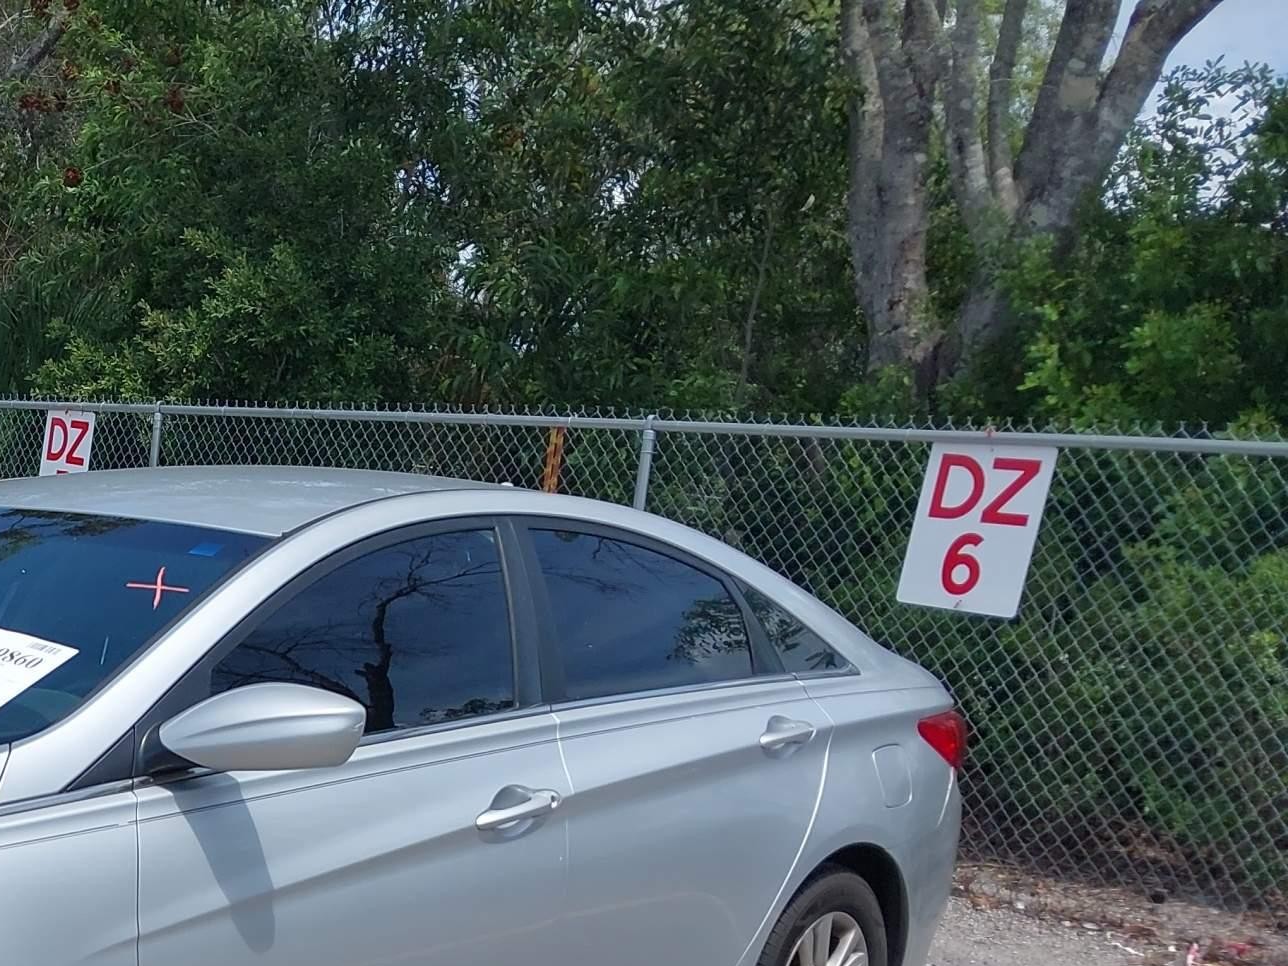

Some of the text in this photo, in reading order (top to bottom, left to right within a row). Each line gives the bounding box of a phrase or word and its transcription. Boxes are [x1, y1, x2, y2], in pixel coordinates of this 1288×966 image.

[46, 417, 89, 466] DZ
[928, 453, 1043, 527] DZ
[941, 532, 985, 596] 6
